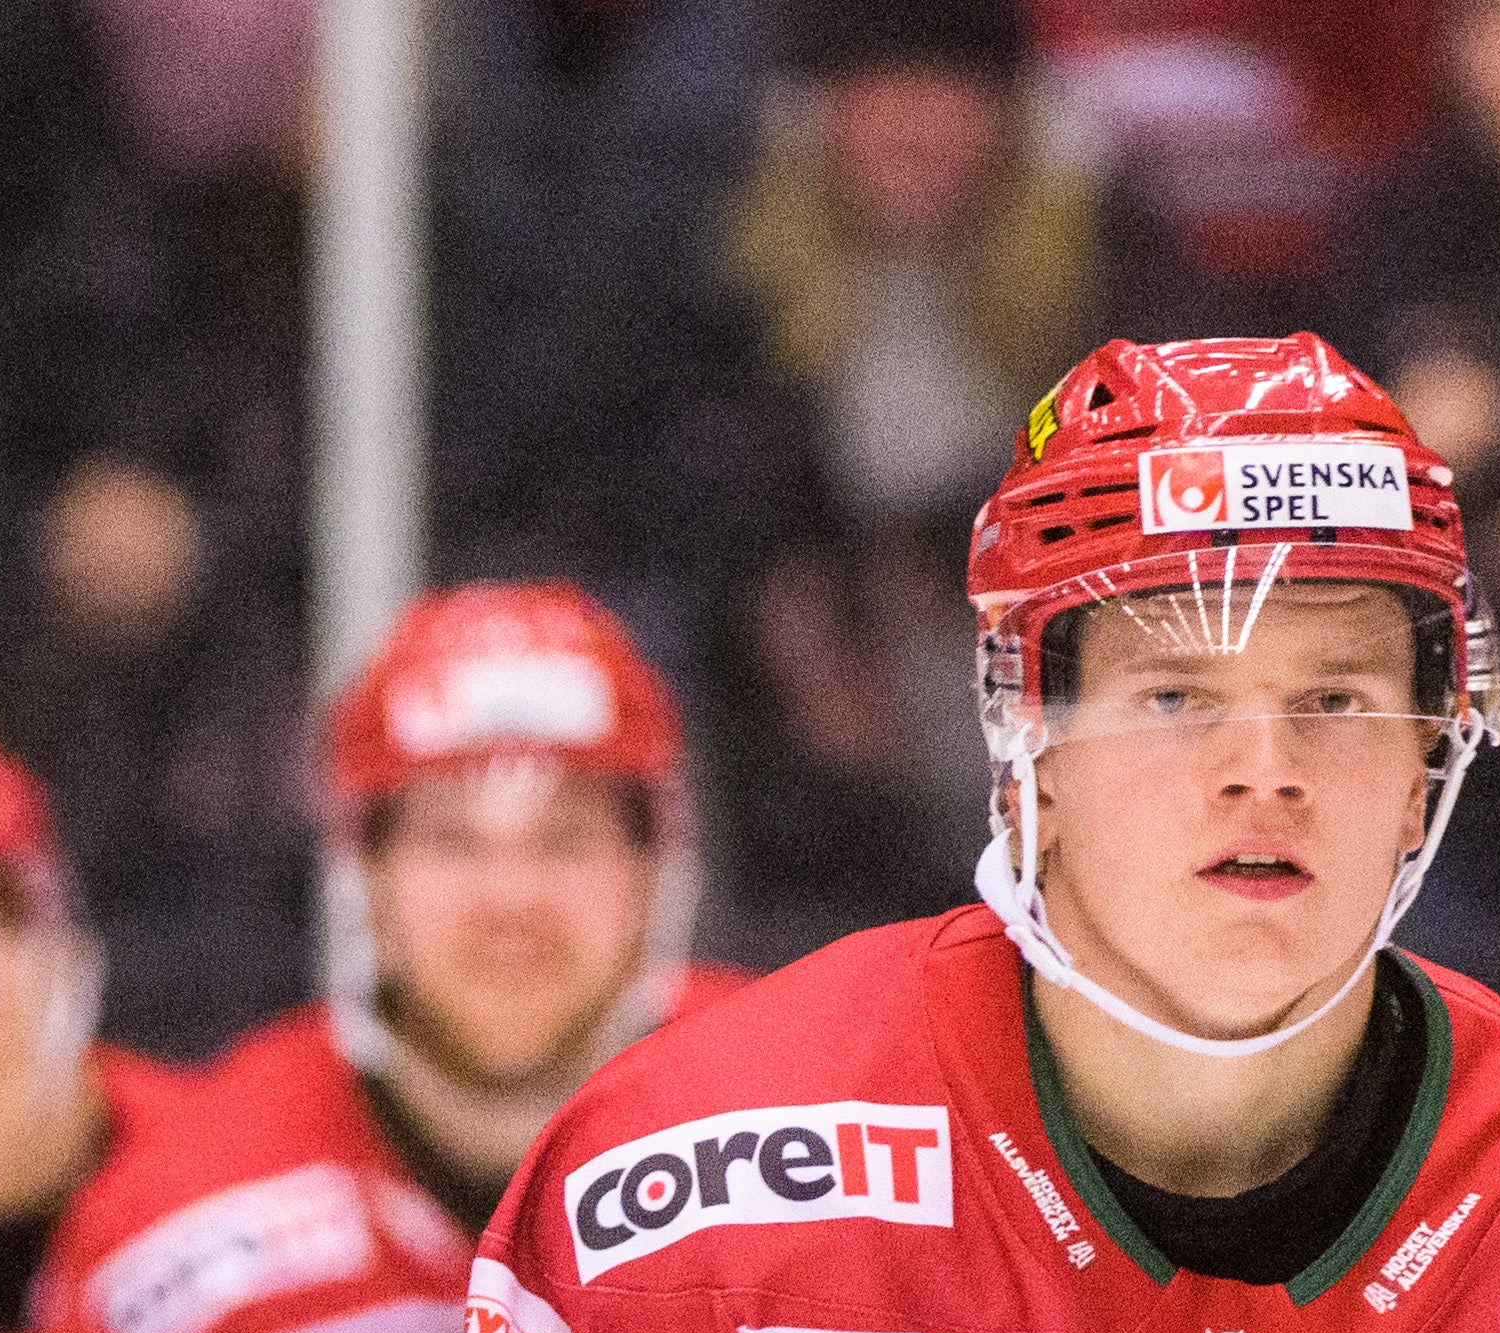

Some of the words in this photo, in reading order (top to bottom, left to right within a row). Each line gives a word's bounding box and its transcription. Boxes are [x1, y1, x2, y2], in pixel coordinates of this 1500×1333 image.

[1240, 461, 1401, 493] SVENSKA
[1242, 494, 1330, 522] SPEL
[1380, 1221, 1434, 1282] HOCKEY
[1396, 1192, 1481, 1291] ALLSVENSKAN
